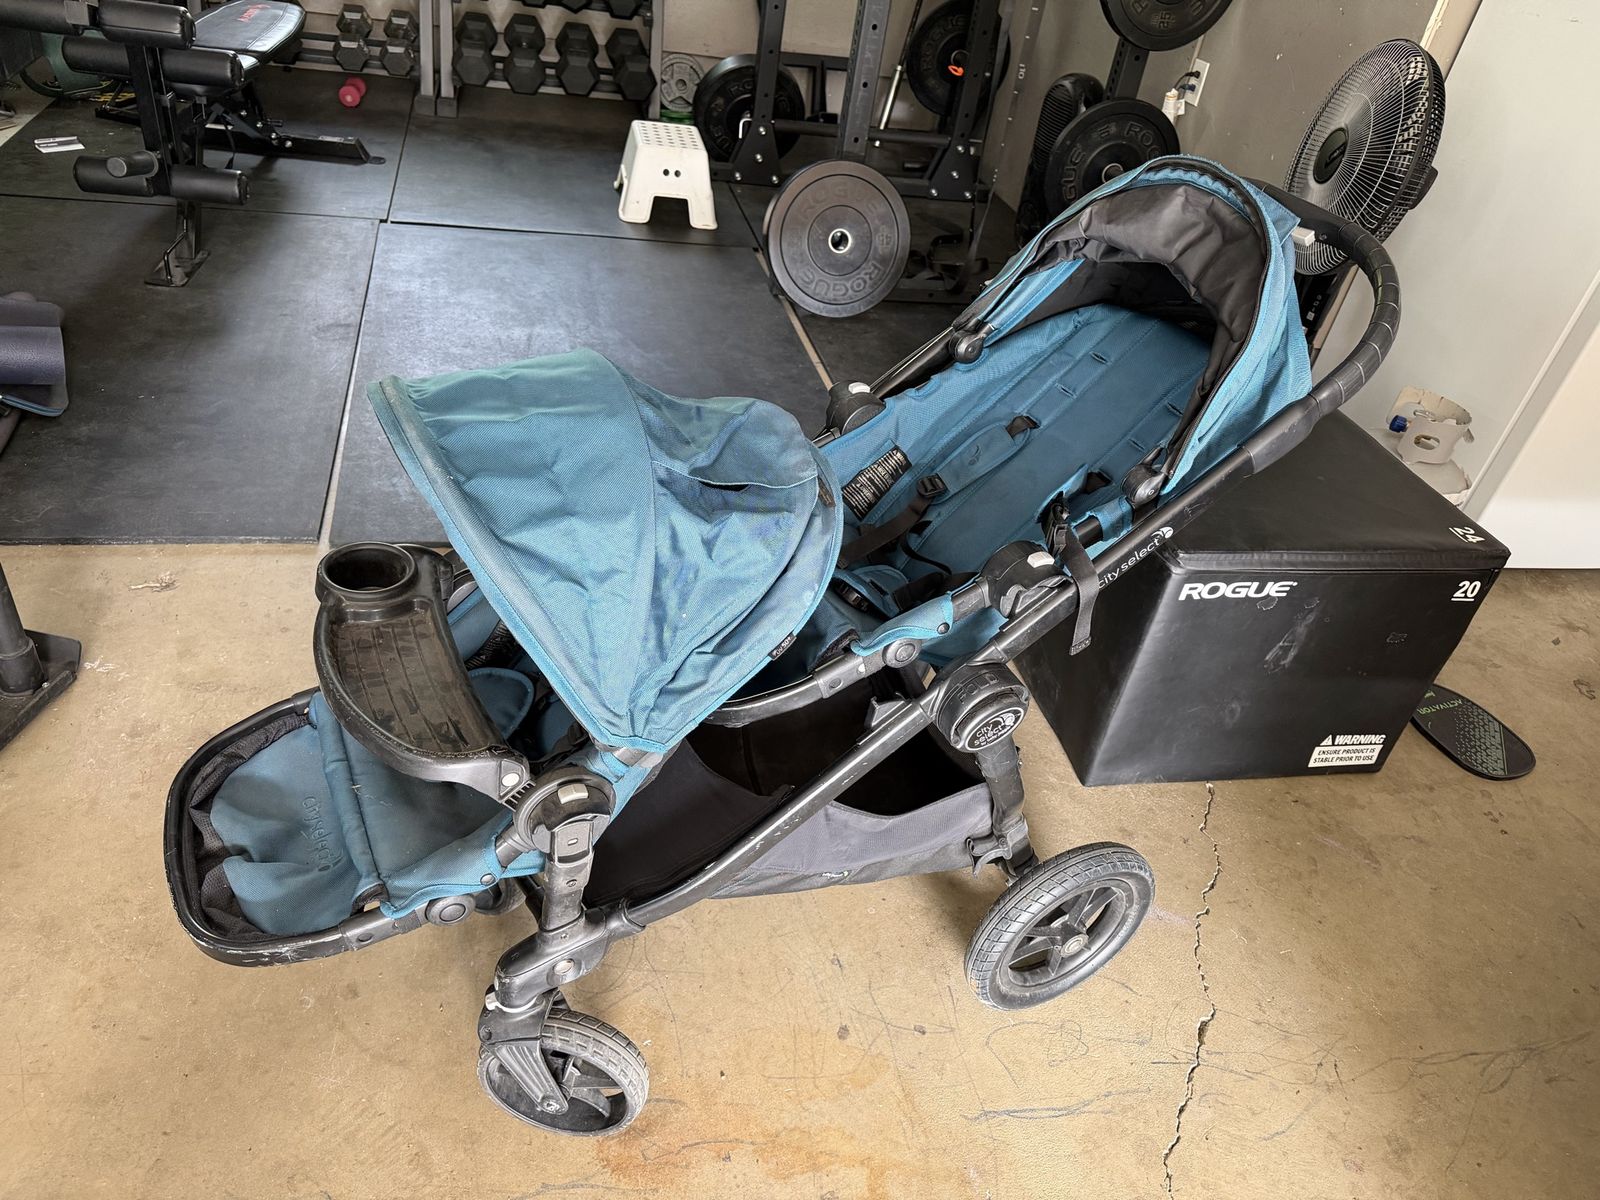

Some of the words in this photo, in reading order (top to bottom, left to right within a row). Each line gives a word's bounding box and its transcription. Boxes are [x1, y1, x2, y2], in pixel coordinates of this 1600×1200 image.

[798, 261, 883, 298] ROGUE
[1453, 526, 1486, 543] 24
[1098, 567, 1120, 589] city
[1121, 537, 1160, 572] select
[1178, 581, 1295, 601] ROGUE
[1452, 580, 1482, 598] 20
[957, 672, 1000, 705] FOLD
[974, 724, 1004, 747] select
[976, 724, 994, 738] city
[1334, 734, 1387, 746] WARNING
